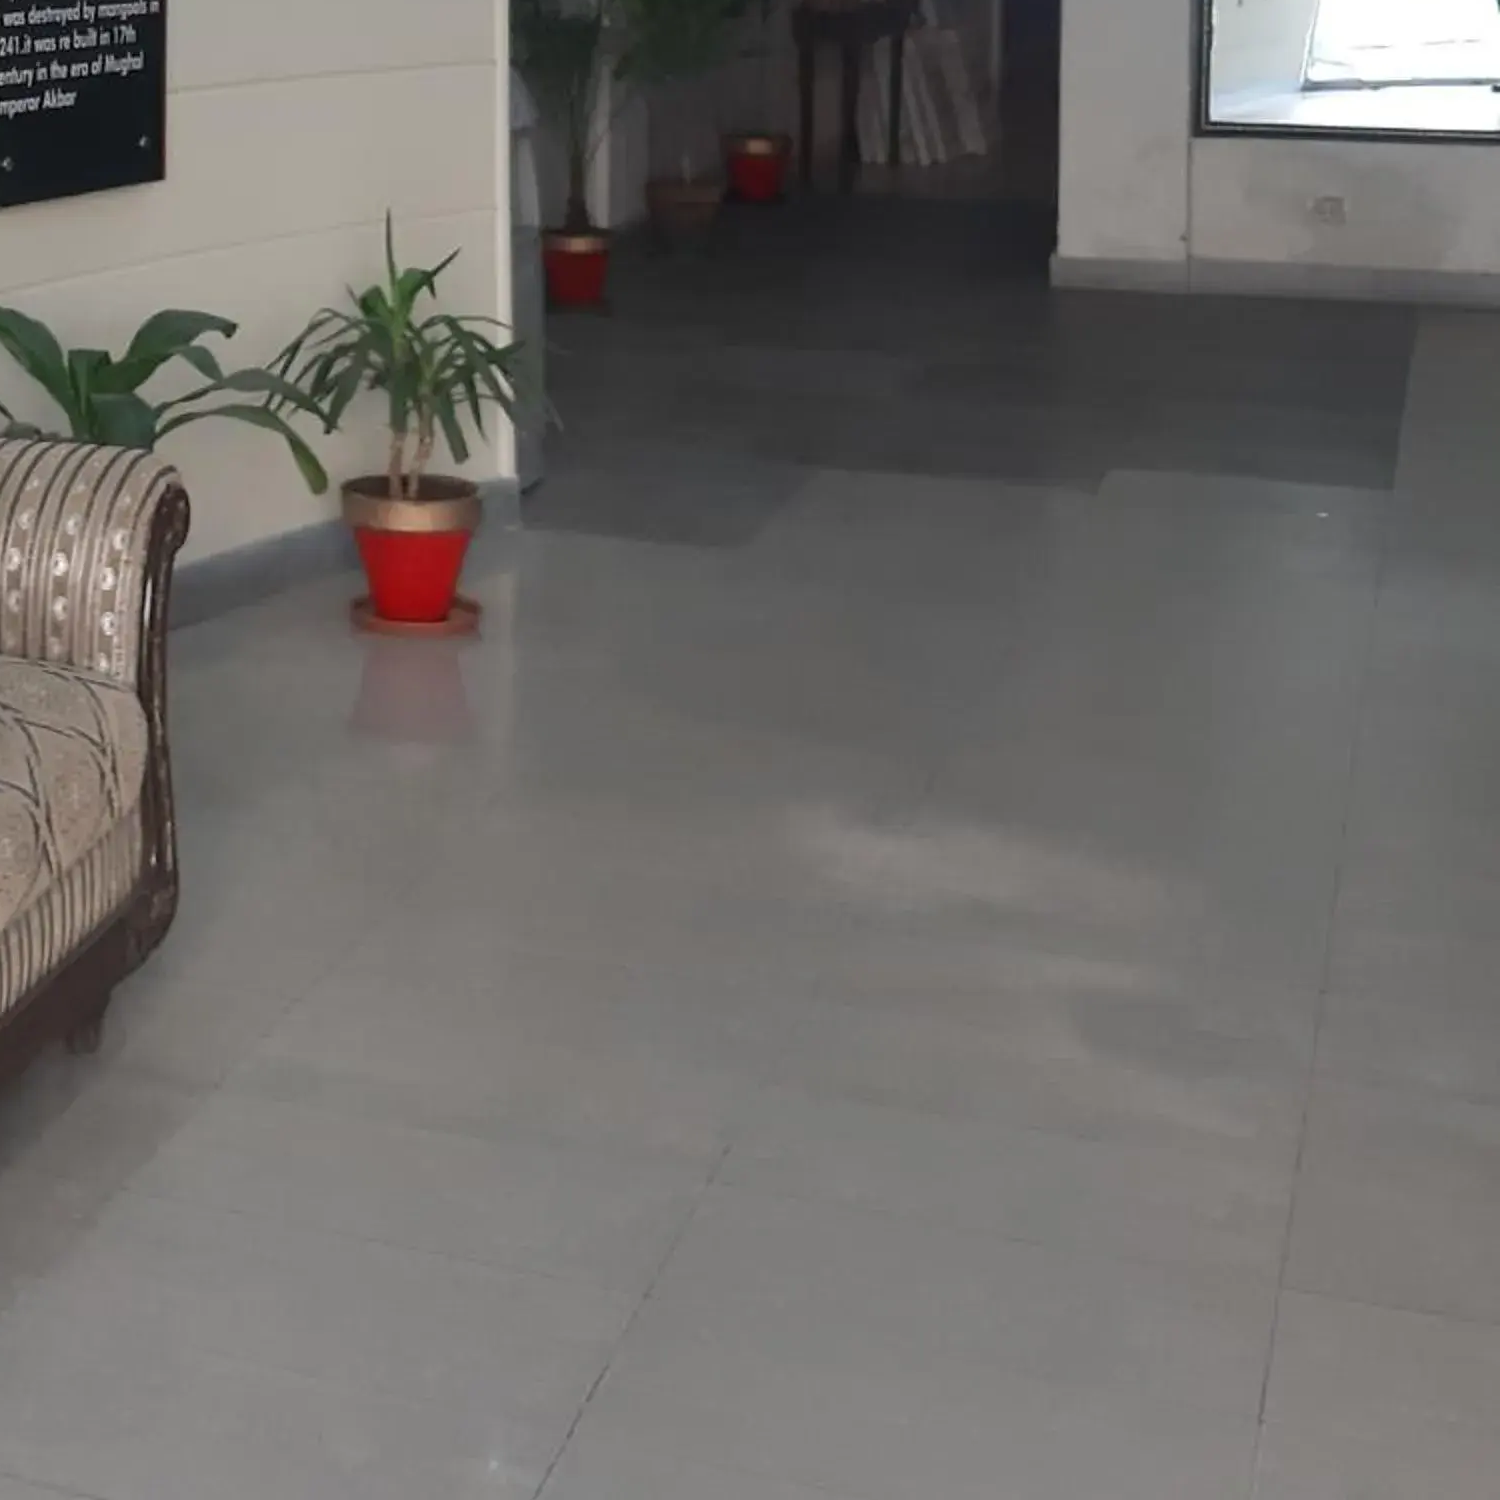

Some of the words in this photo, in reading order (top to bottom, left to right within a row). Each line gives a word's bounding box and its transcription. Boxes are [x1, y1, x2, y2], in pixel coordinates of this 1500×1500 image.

[3, 11, 25, 26] was
[28, 1, 80, 26] destroyed
[83, 0, 95, 22] by
[34, 37, 56, 53] was
[73, 28, 97, 49] built
[100, 27, 110, 45] in
[113, 24, 136, 44] 17th
[37, 61, 48, 81] in
[50, 58, 67, 79] the
[70, 62, 89, 78] era
[92, 52, 103, 74] of
[105, 50, 144, 76] Mughal
[42, 87, 77, 109] Akbar
